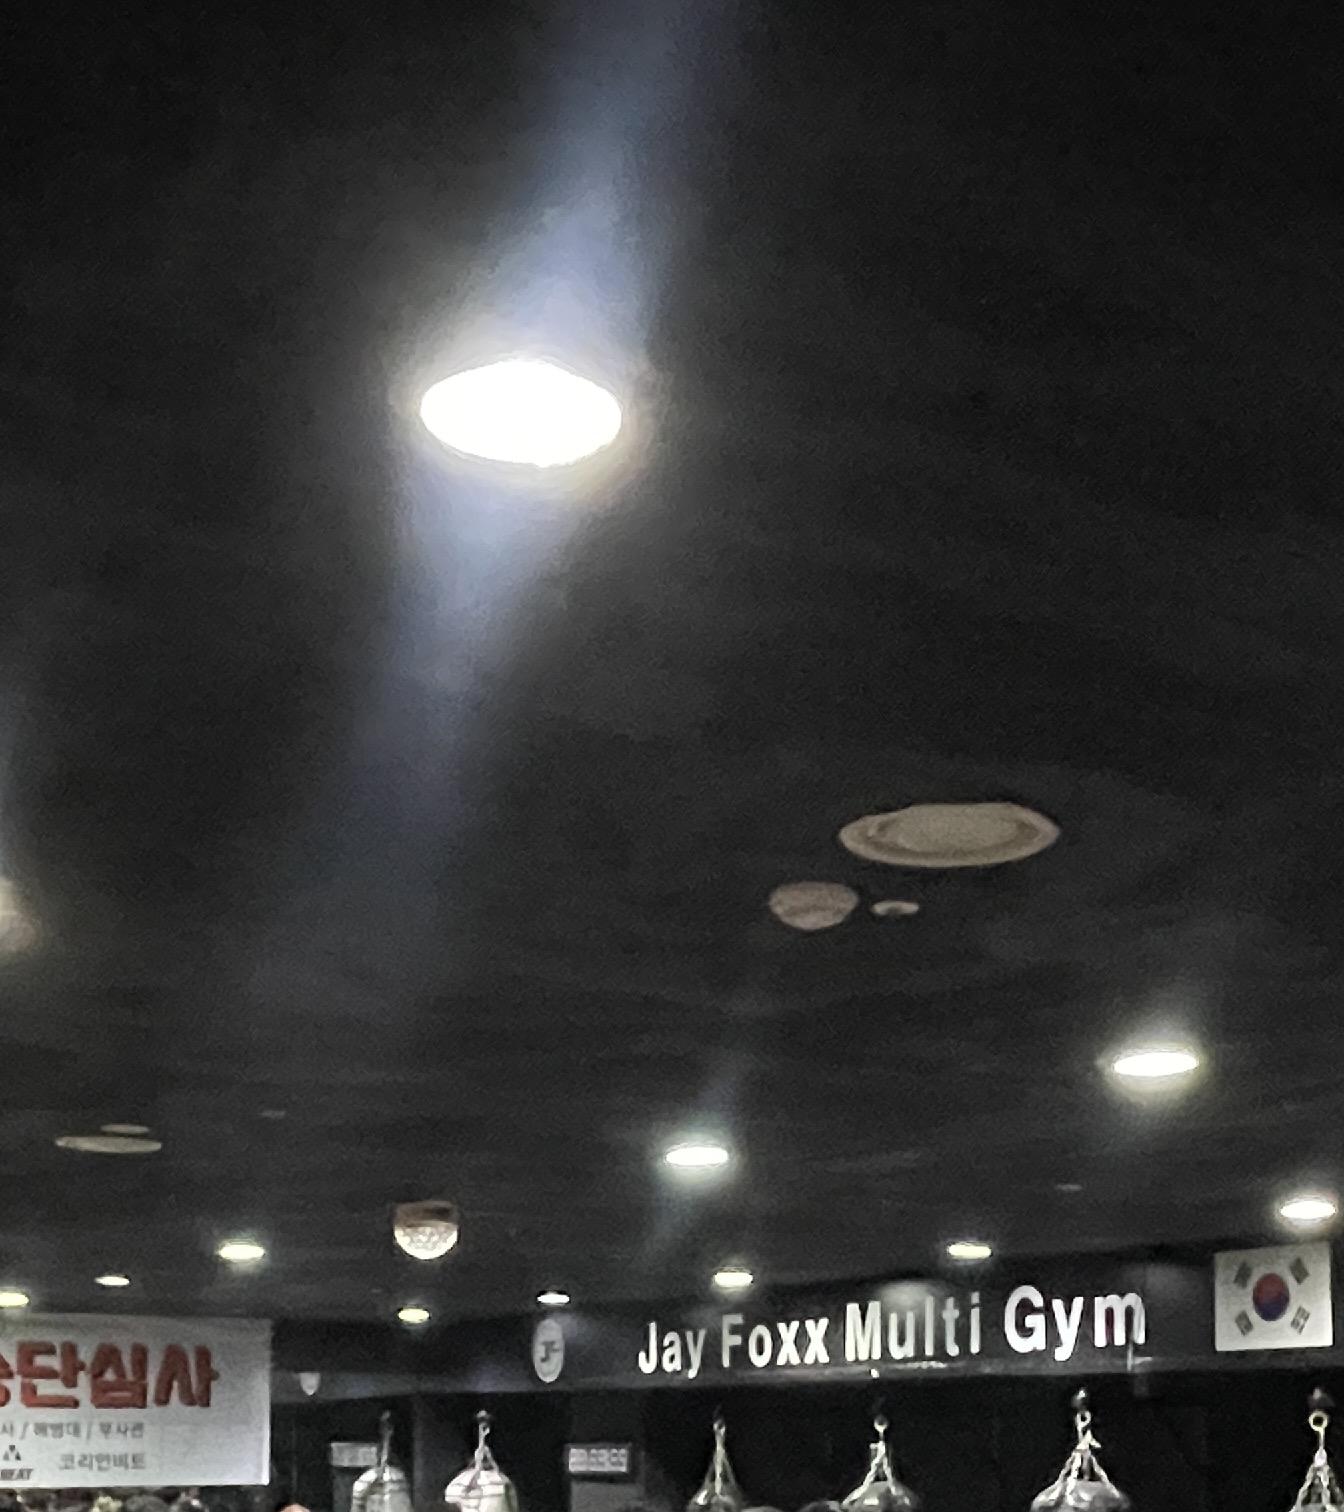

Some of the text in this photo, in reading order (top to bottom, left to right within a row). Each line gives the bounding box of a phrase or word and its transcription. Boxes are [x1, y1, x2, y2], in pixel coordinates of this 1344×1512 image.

[638, 1284, 1147, 1380] Jay Foxx Multi Gym
